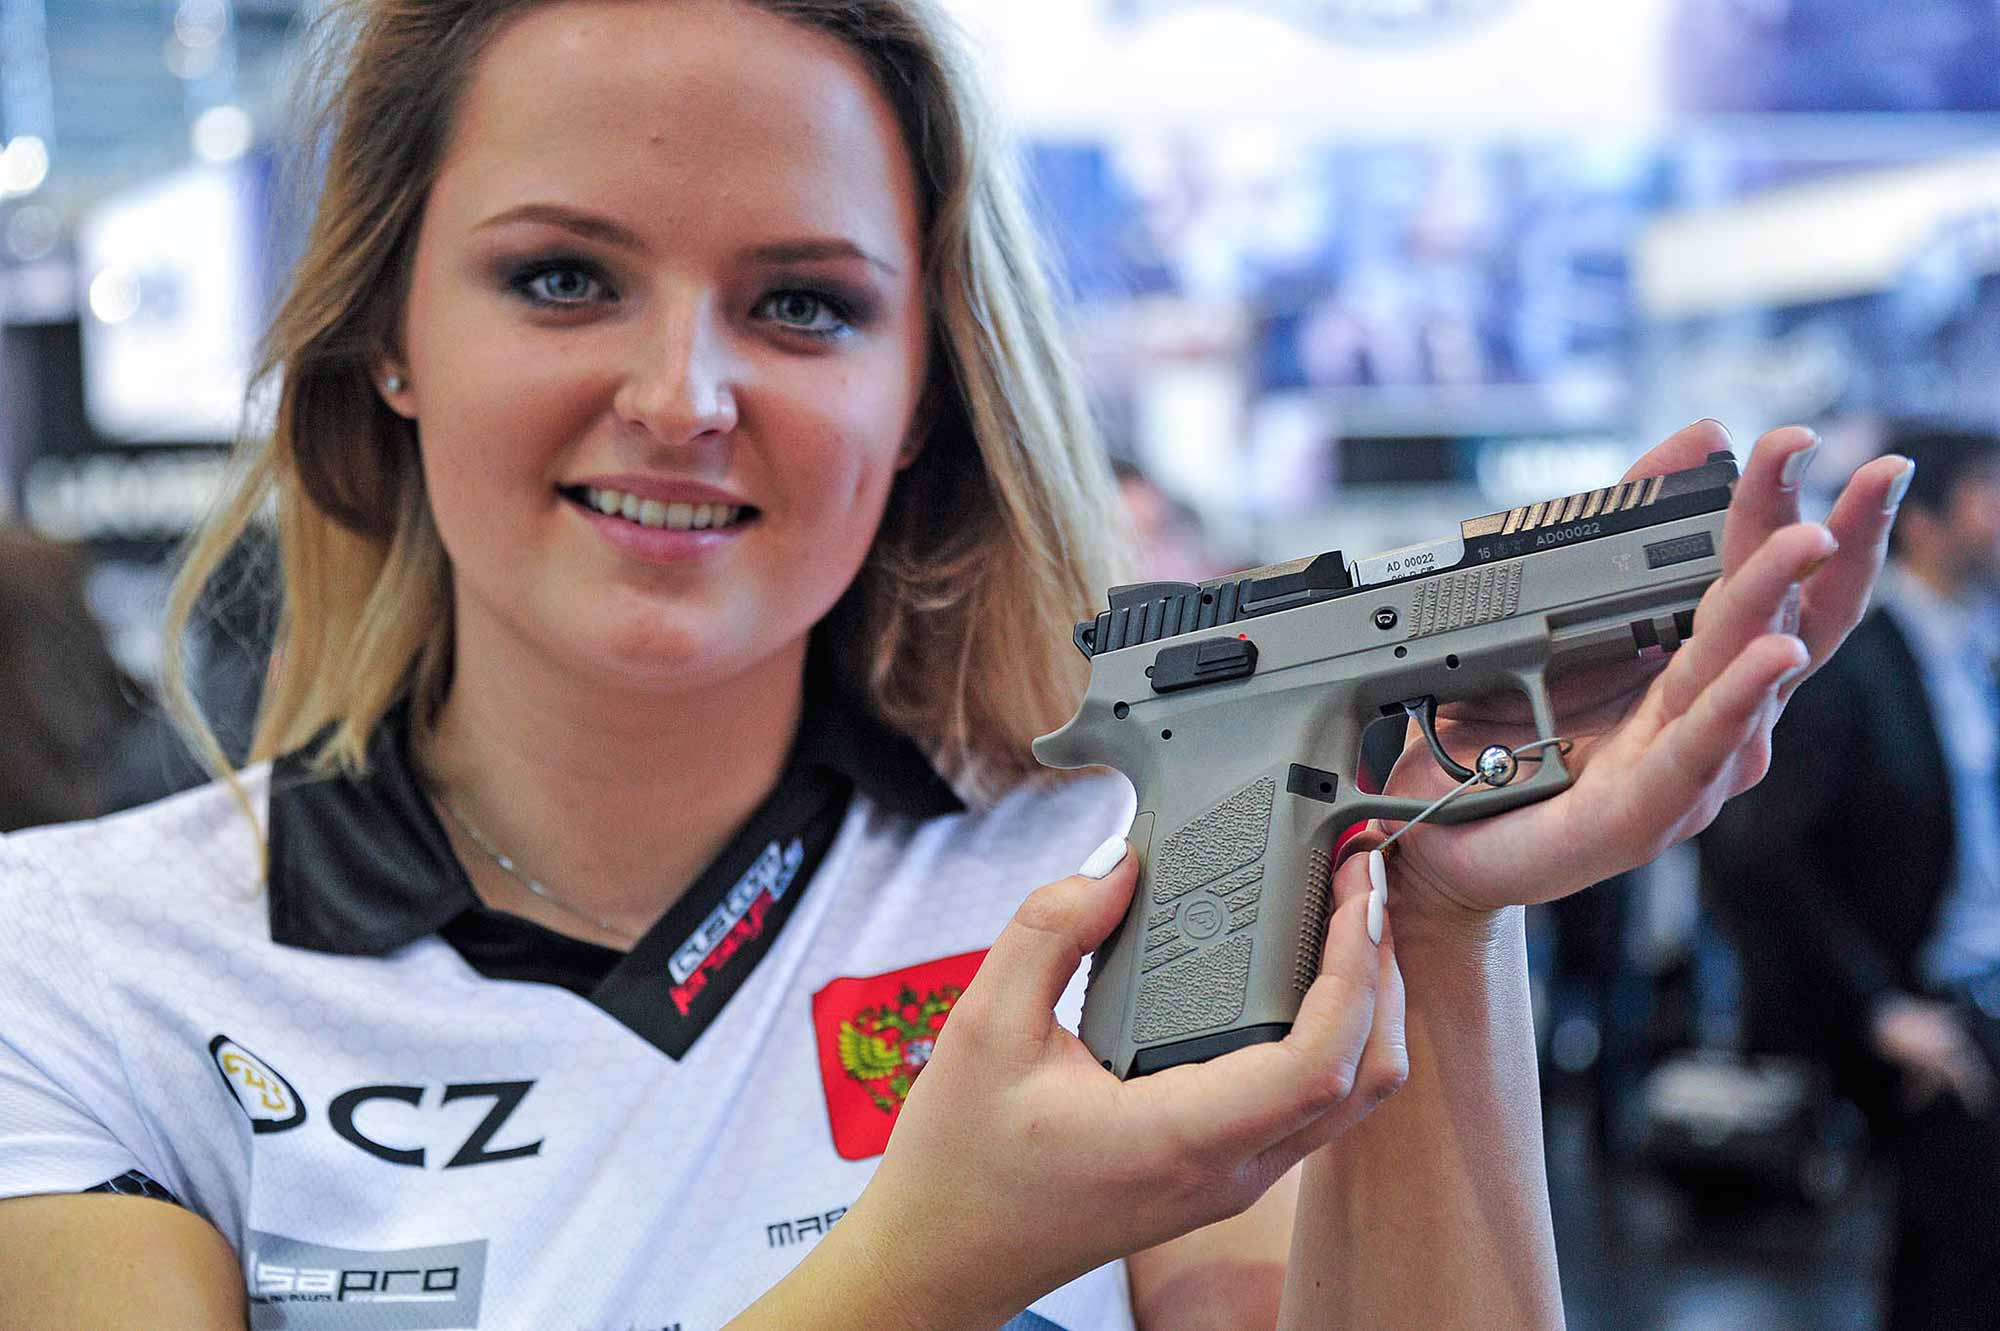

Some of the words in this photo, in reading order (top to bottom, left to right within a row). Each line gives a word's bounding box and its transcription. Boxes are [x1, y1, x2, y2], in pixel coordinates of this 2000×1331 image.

[1535, 522, 1600, 547] AD00022
[1386, 561, 1400, 573] AD
[1404, 552, 1435, 568] 00022
[328, 1080, 546, 1169] CZ
